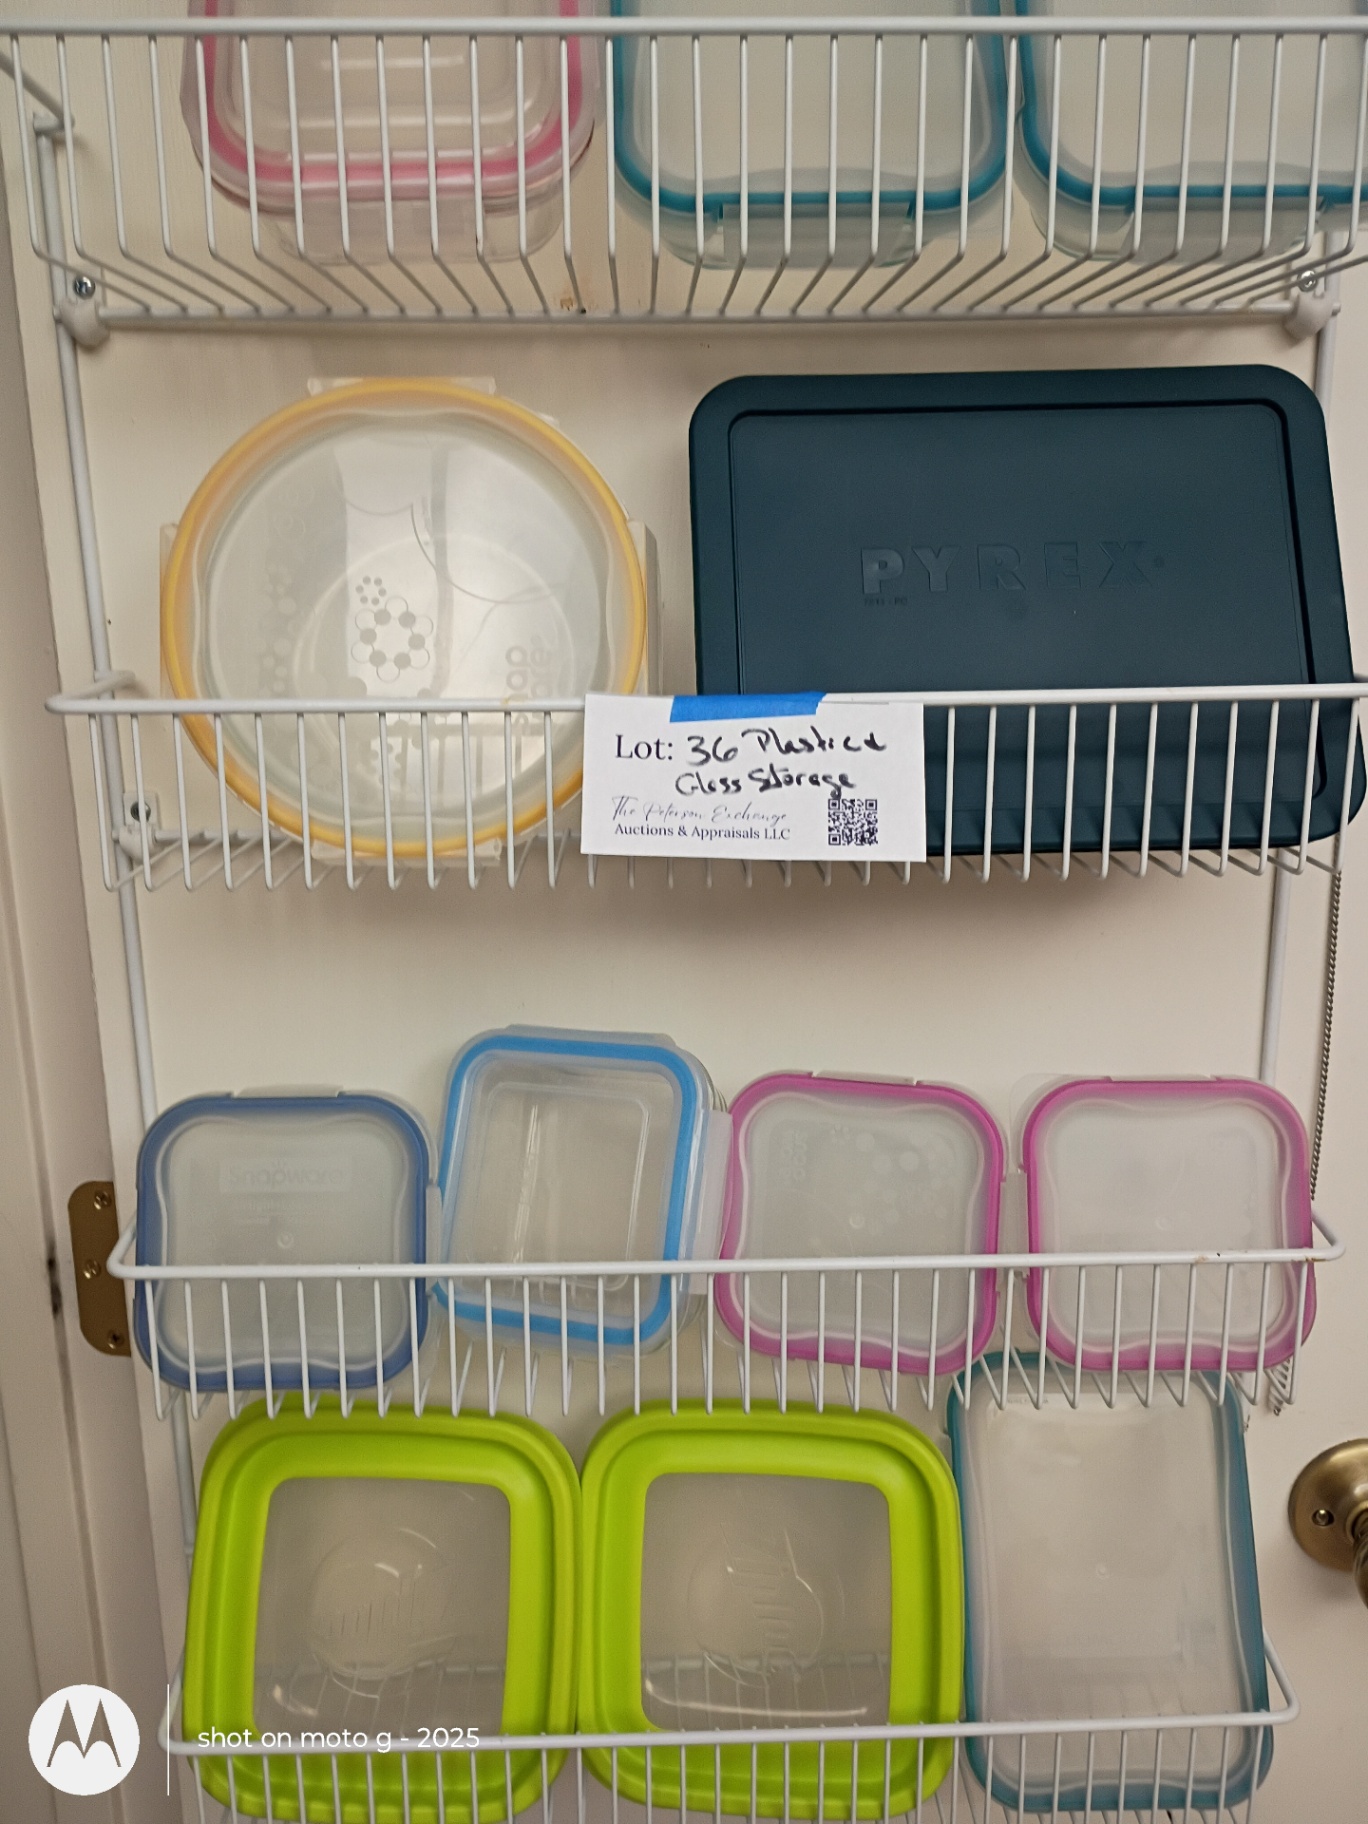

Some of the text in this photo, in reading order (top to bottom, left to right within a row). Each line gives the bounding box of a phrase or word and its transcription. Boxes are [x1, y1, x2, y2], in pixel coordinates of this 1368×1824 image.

[860, 541, 1151, 595] PYREX
[616, 734, 673, 760] Lot:
[686, 736, 738, 766] 36
[748, 763, 856, 800] Storage
[612, 795, 638, 821] The
[614, 824, 791, 841] Auctions & Appraisals LLC
